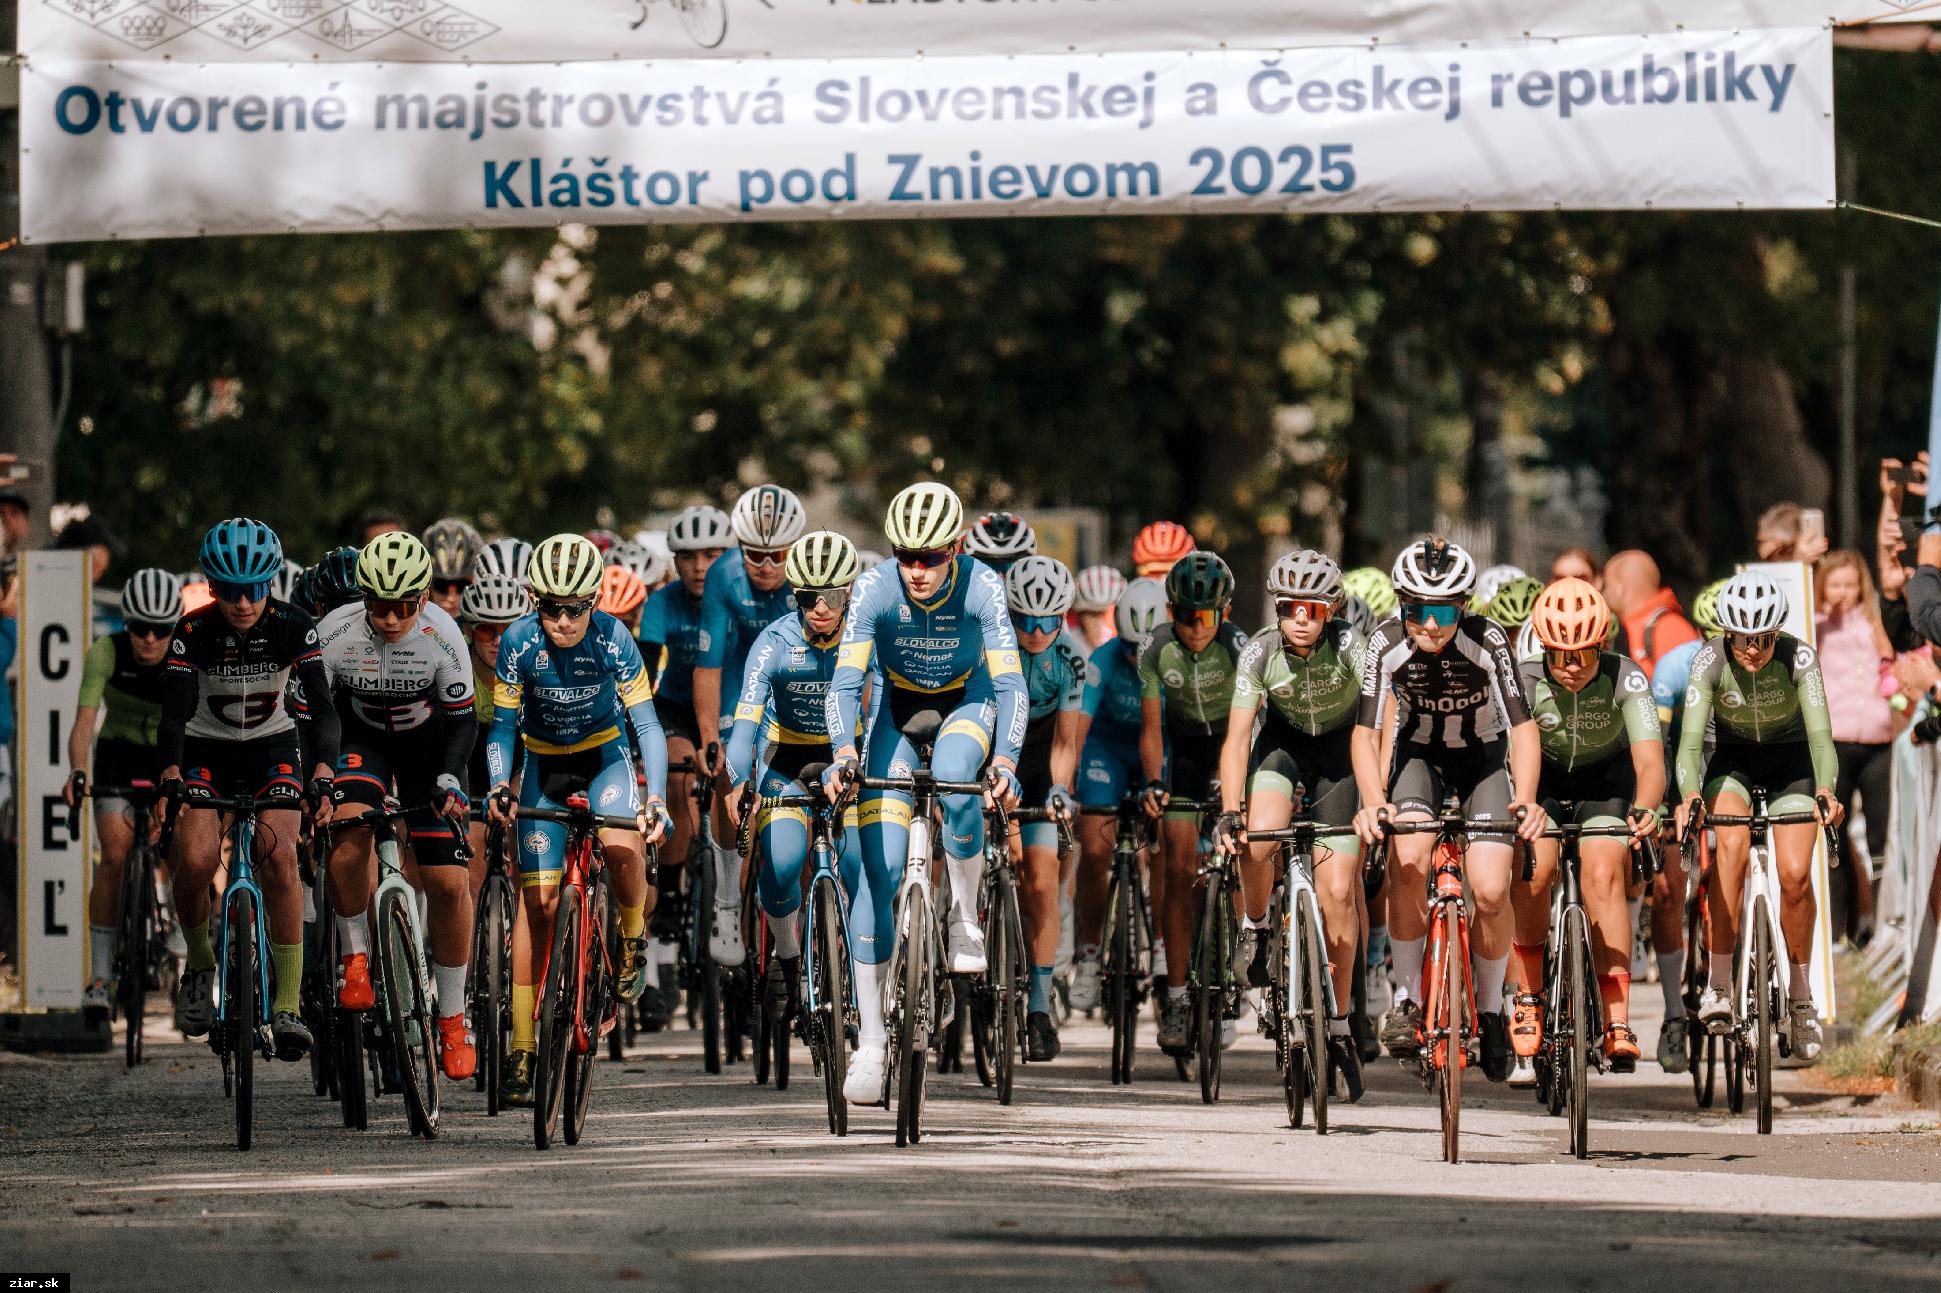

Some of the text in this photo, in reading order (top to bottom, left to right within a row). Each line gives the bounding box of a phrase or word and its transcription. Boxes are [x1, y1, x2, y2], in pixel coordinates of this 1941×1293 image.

[55, 50, 1797, 141] Otvorené majstrovstvá Slovenskej a Českej republiky
[483, 143, 1357, 212] Kláštor pod Znievom 2025
[842, 568, 882, 642] DATALAN
[979, 570, 1014, 648] DATALAN
[895, 638, 960, 649] SLOVALCO
[208, 661, 280, 676] CLIMBERG
[744, 644, 774, 703] DATALAN
[1362, 630, 1390, 697] MAXCURSOR
[1693, 653, 1717, 681] GROUP
[533, 687, 601, 702] SLOVALCO
[1300, 677, 1342, 690] CARGO
[1747, 689, 1785, 700] CARGO
[1805, 671, 1819, 707] GROUP
[1565, 720, 1610, 730] GROUP
[1566, 711, 1611, 722] CARGO
[1637, 697, 1654, 731] GROUP
